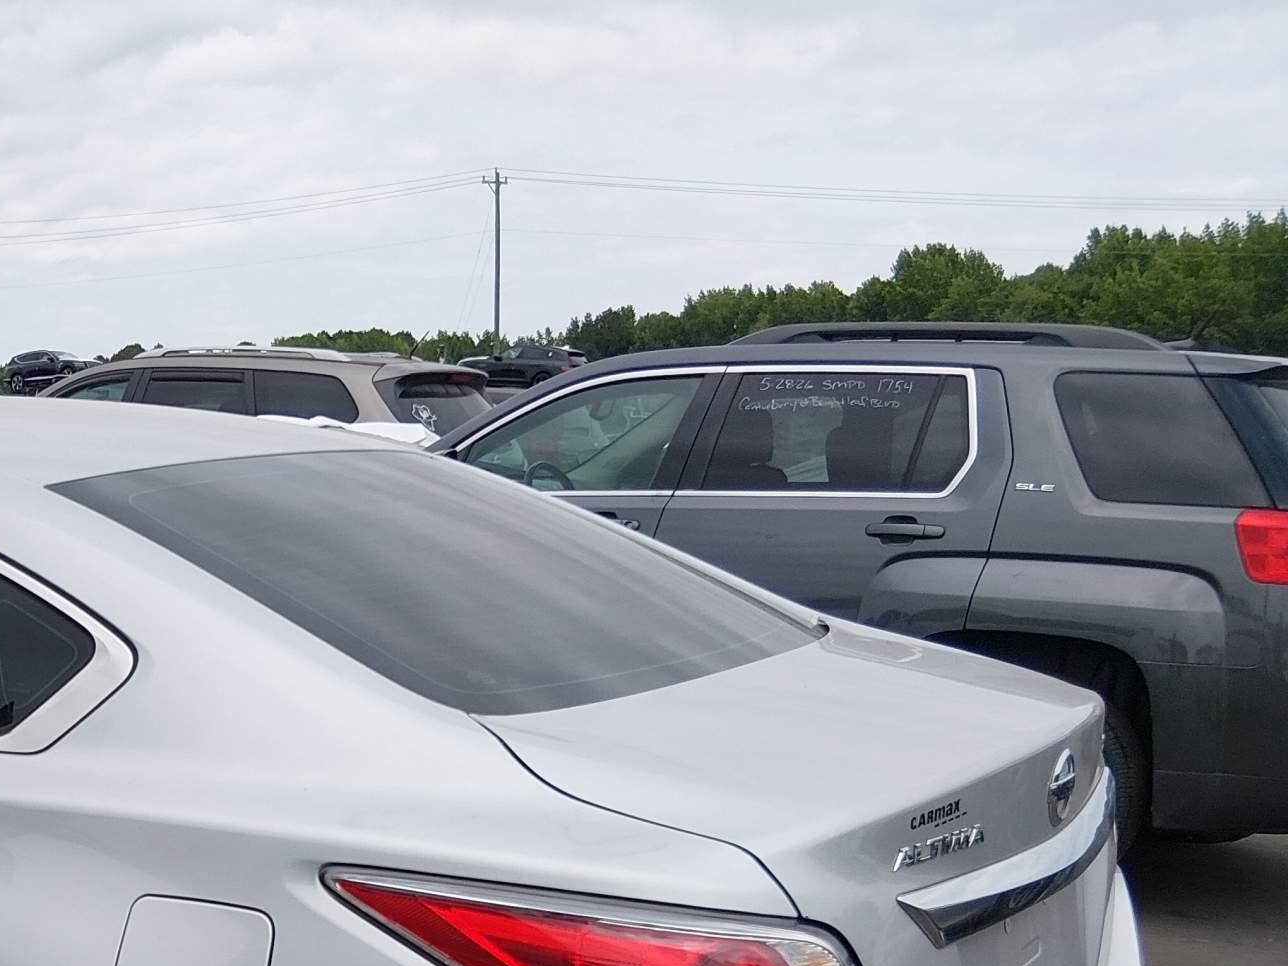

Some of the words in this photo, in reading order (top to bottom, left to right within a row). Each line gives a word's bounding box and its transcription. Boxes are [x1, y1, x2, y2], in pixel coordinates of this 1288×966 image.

[822, 379, 866, 391] SMPD
[877, 378, 913, 393] 1754
[1015, 483, 1055, 492] SLE
[891, 823, 985, 872] ALTIMA
